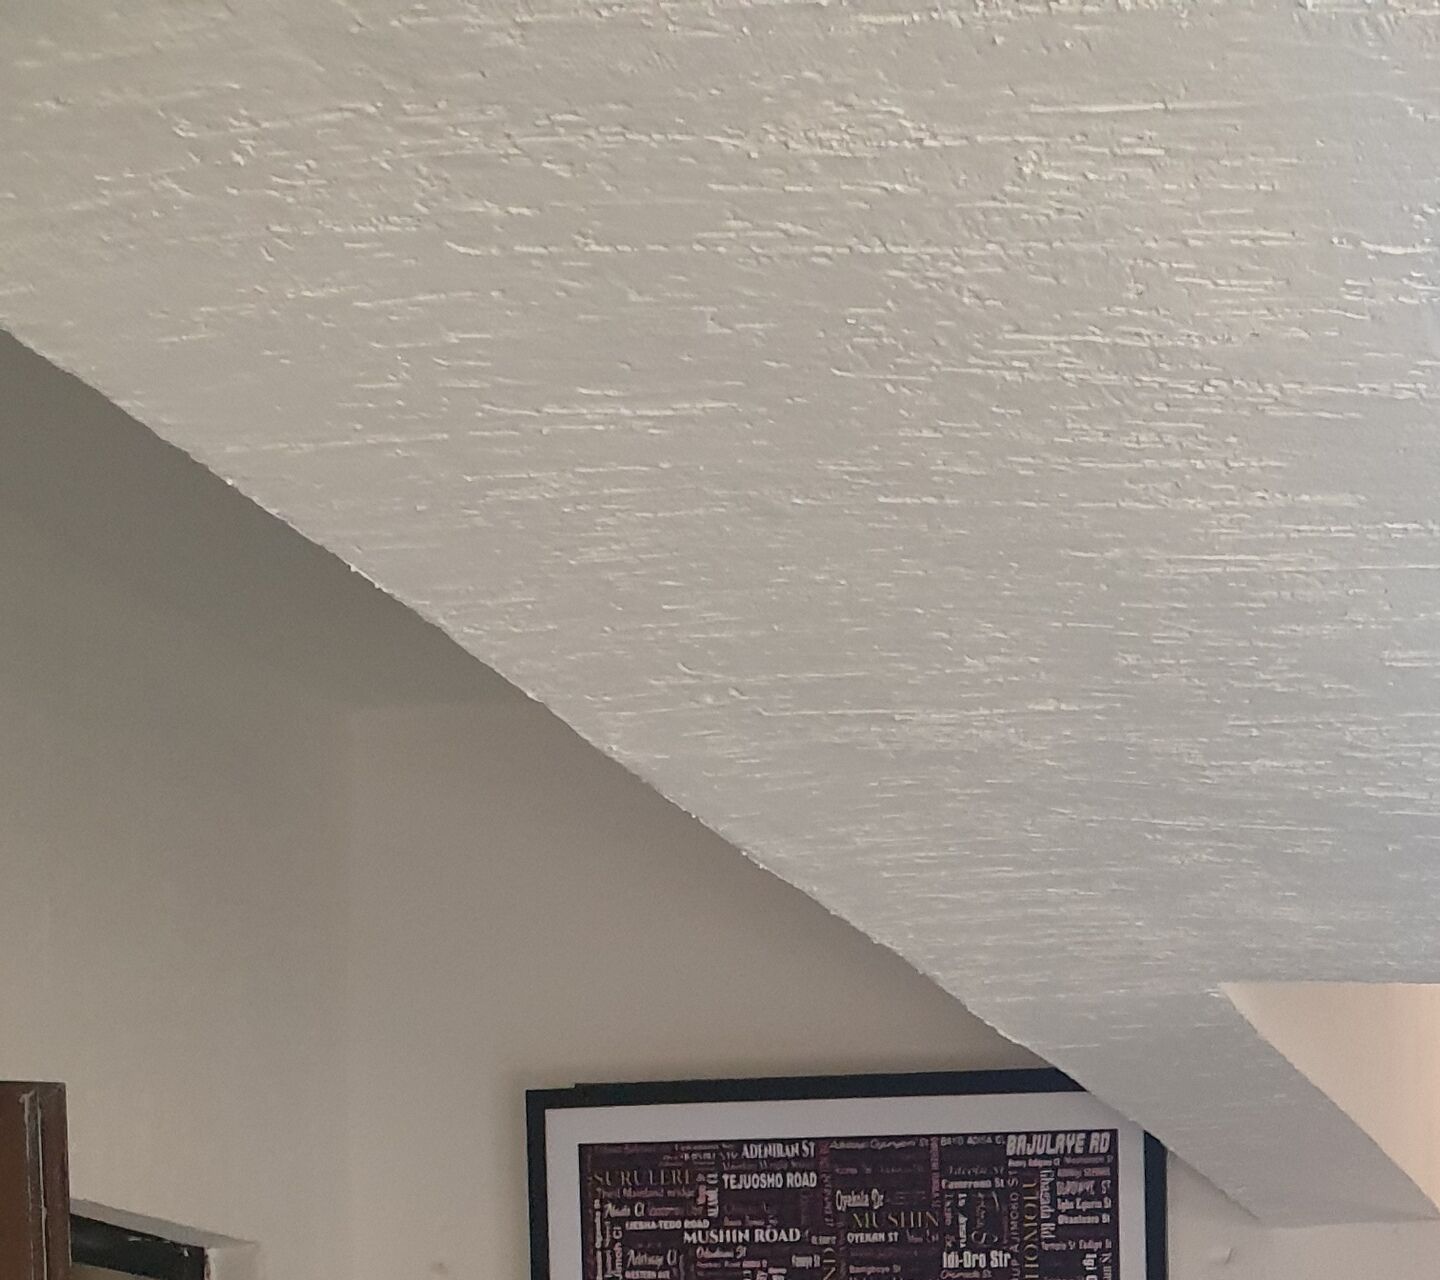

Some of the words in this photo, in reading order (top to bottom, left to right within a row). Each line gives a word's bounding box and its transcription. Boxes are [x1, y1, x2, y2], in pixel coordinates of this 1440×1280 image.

[803, 1140, 816, 1158] ST
[1007, 1134, 1087, 1155] BAJULAYE
[1089, 1133, 1112, 1154] RD
[722, 1173, 784, 1190] TEJUOSHO
[787, 1172, 818, 1188] ROAD
[683, 1229, 750, 1245] MUSHIN
[754, 1228, 801, 1243] ROAD
[990, 1250, 1012, 1268] Str
